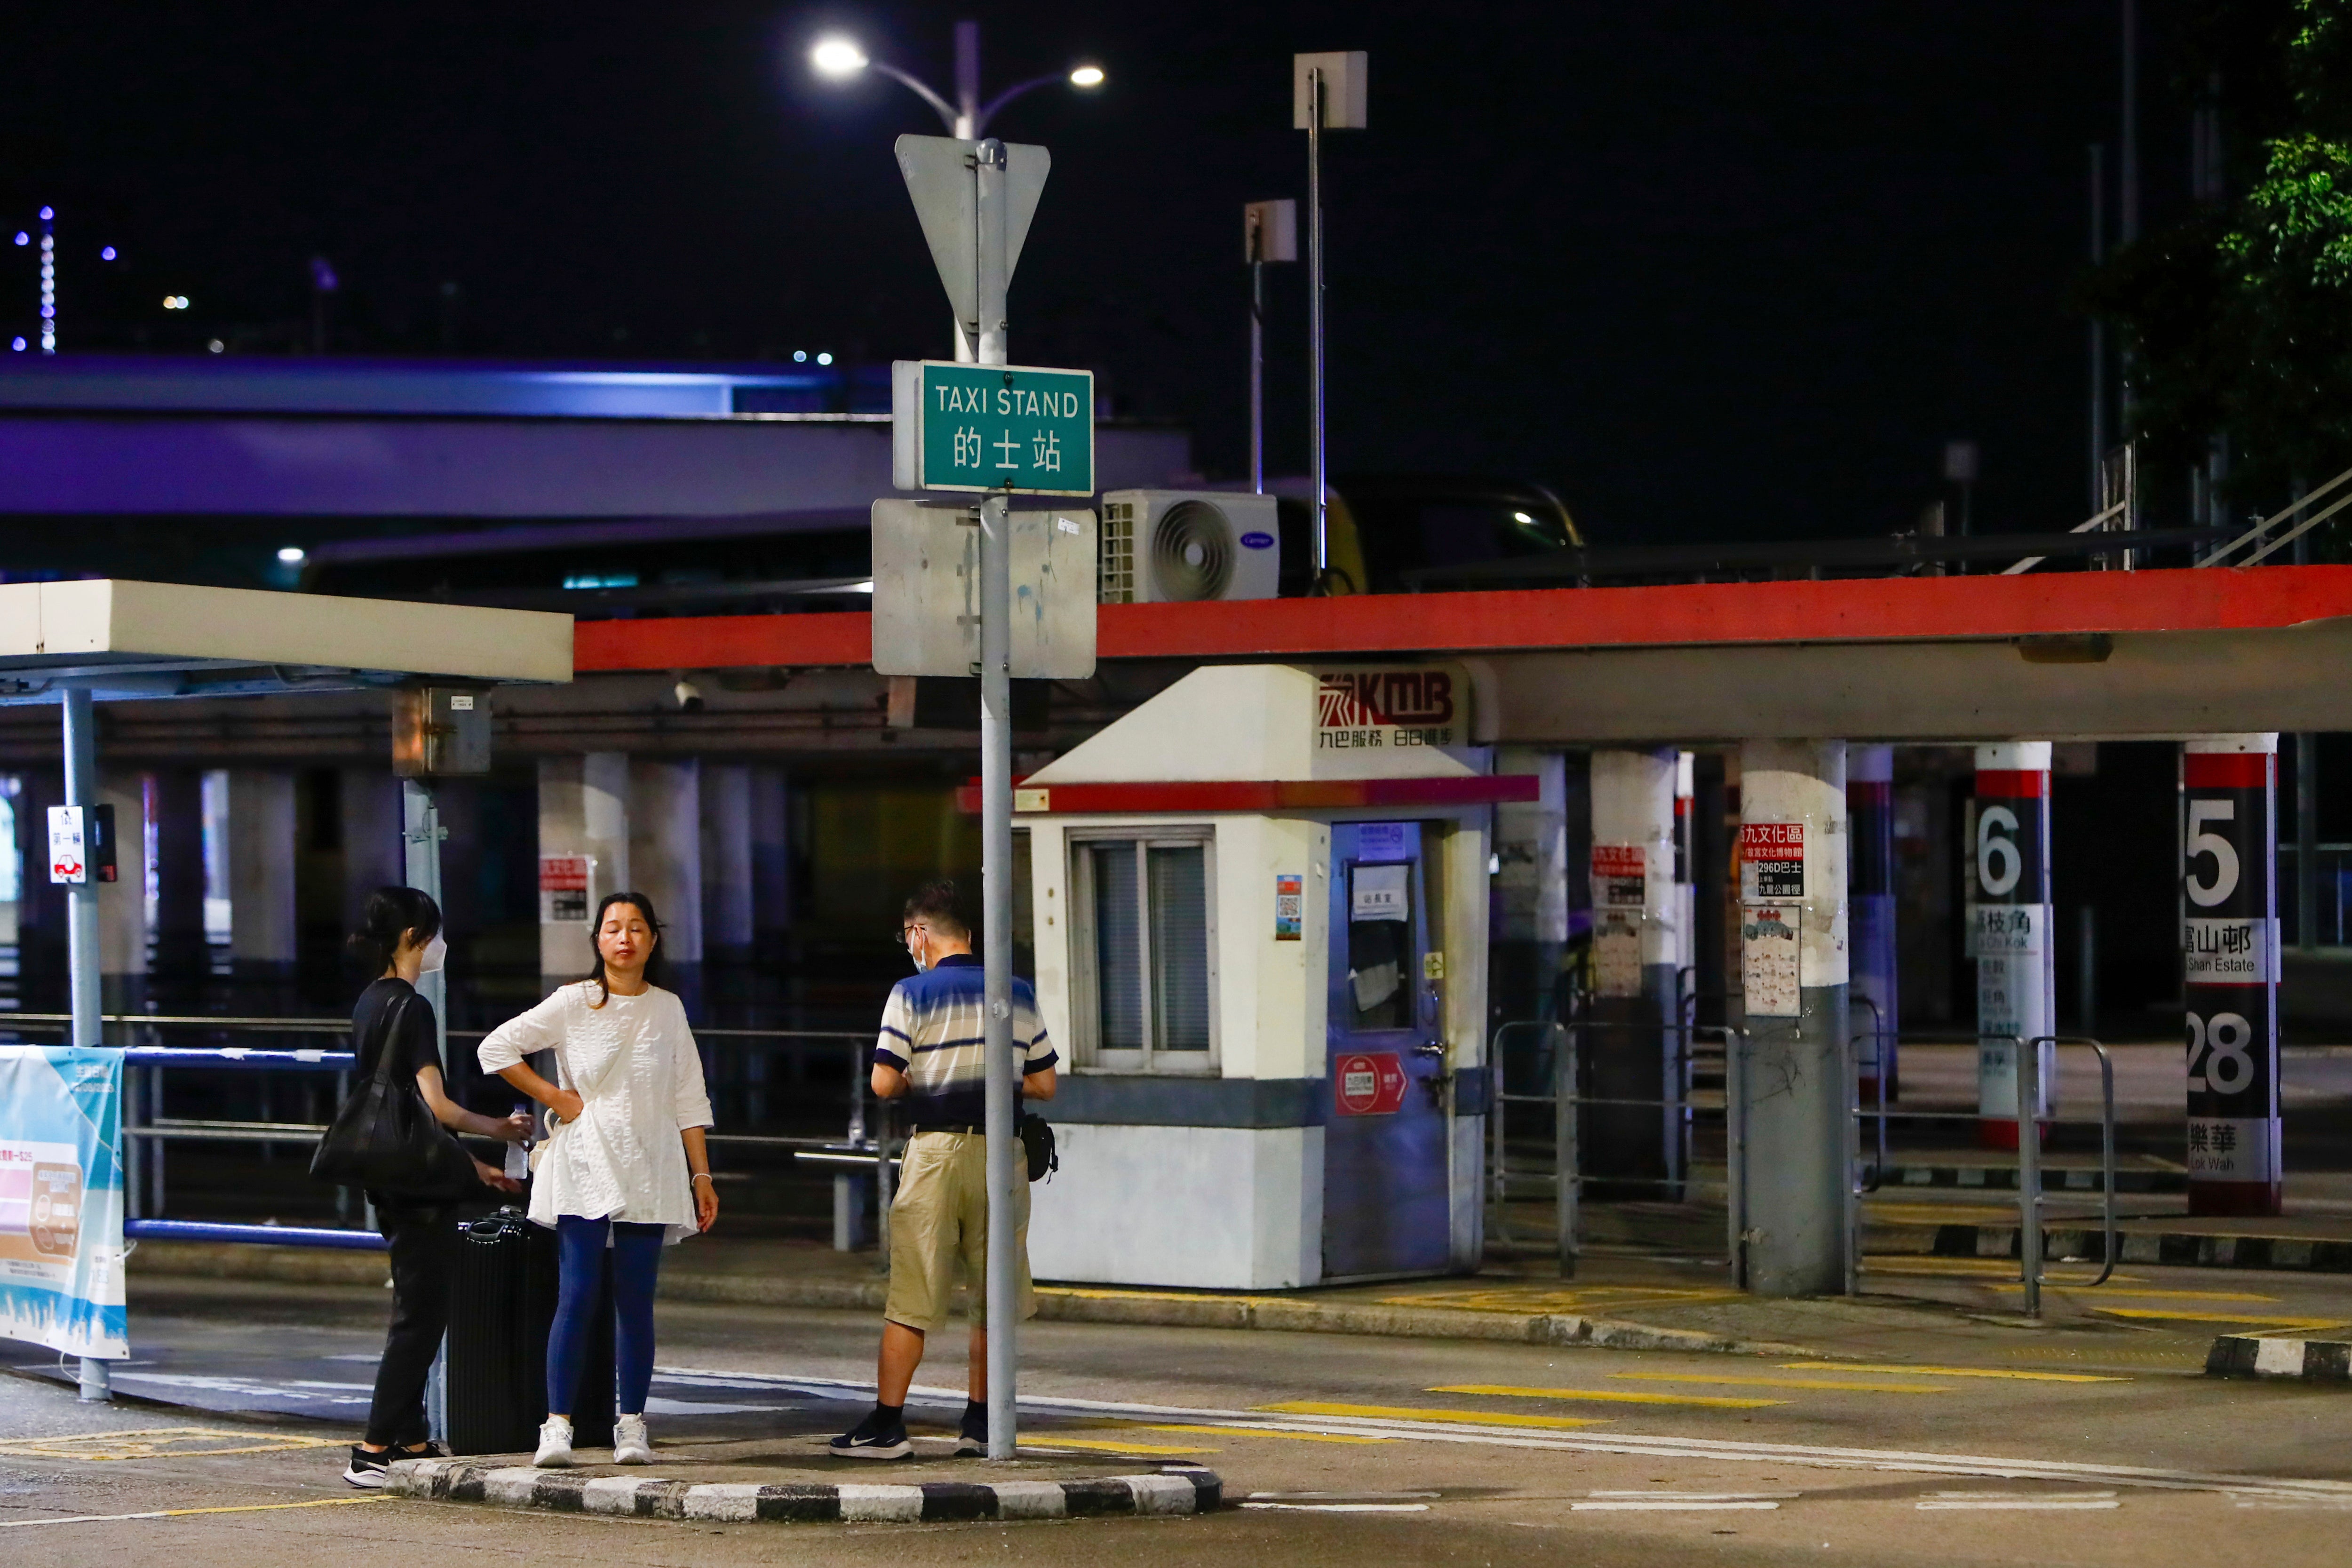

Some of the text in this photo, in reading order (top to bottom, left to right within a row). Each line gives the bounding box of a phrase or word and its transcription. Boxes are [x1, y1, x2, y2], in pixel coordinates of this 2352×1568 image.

[935, 385, 1078, 418] TAXI STAND
[954, 426, 1060, 472] 的士站
[1359, 672, 1454, 725] KMB
[1320, 729, 1383, 748] 九巴服務
[1977, 805, 2021, 896] 6
[2186, 799, 2240, 907] 5
[2188, 957, 2254, 972] Shan Estate
[2186, 1011, 2254, 1094] 28
[2190, 1123, 2236, 1154] 樂華
[2209, 1157, 2234, 1170] Wah
